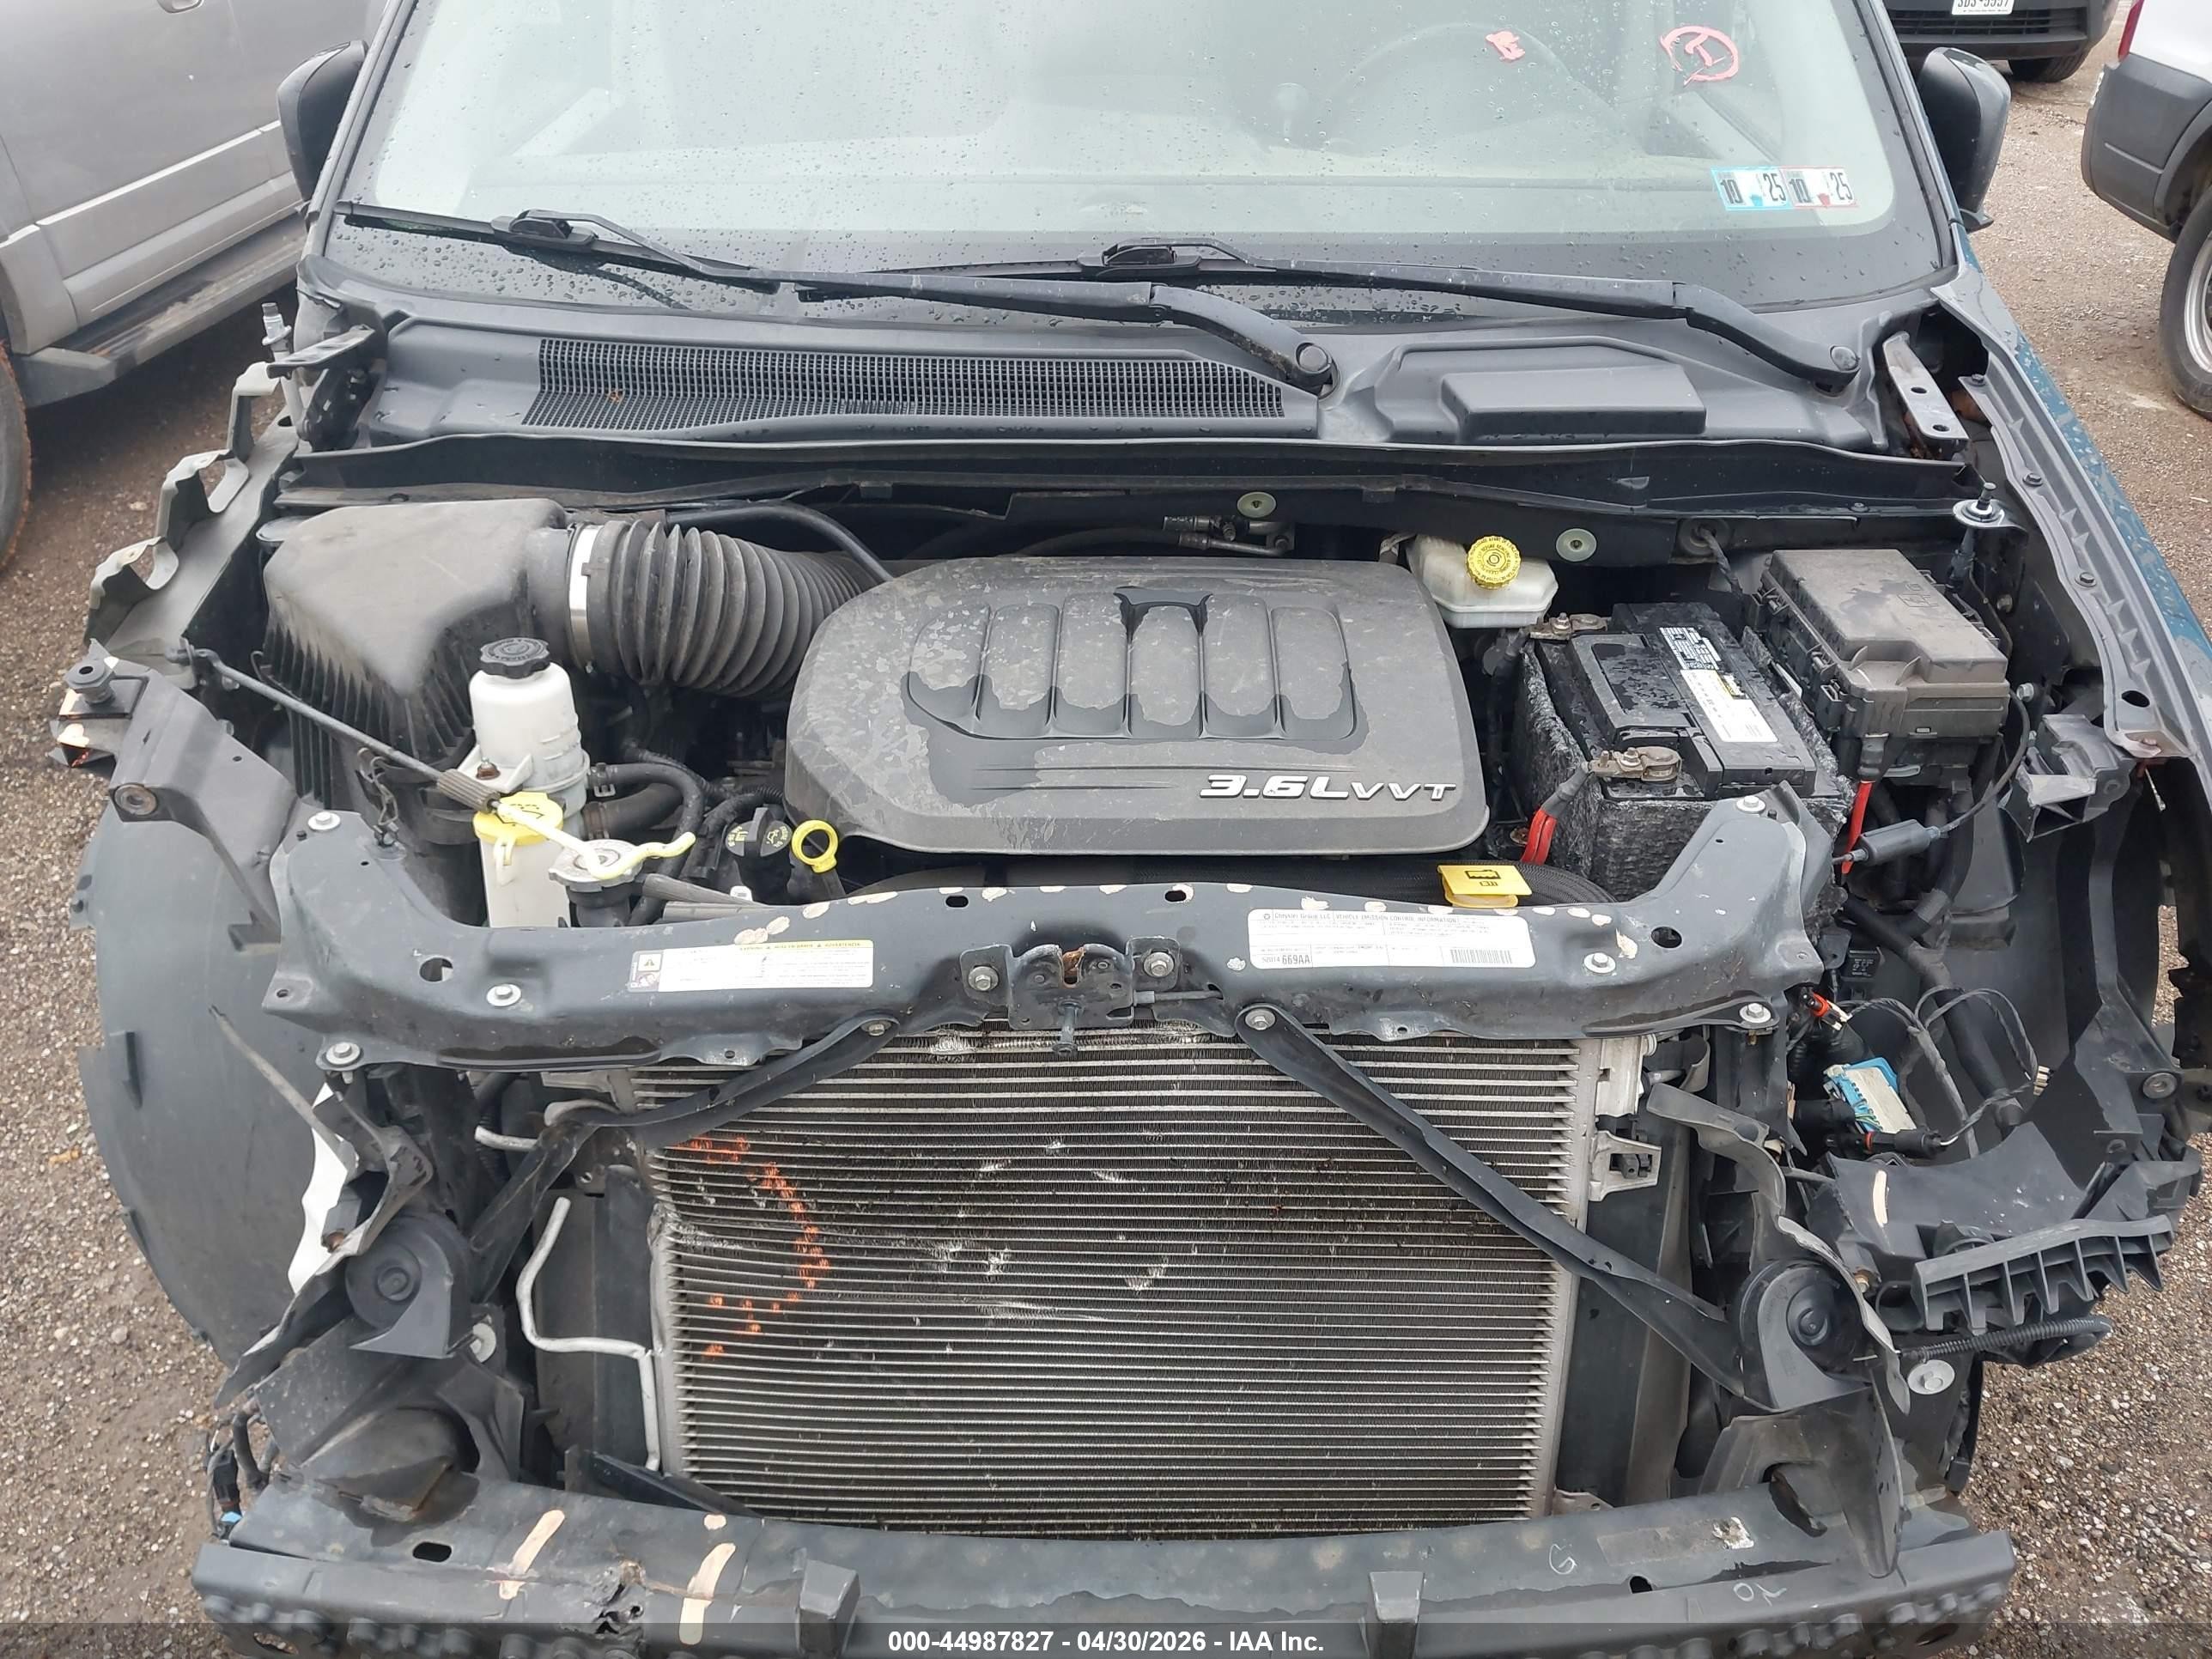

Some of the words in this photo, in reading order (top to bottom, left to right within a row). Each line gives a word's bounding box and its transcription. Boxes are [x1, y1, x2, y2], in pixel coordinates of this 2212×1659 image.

[1720, 179, 1743, 204] 10
[1763, 173, 1787, 203] 25
[1789, 178, 1812, 204] 10
[1830, 172, 1854, 201] 25
[1282, 954, 1310, 965] 669AA
